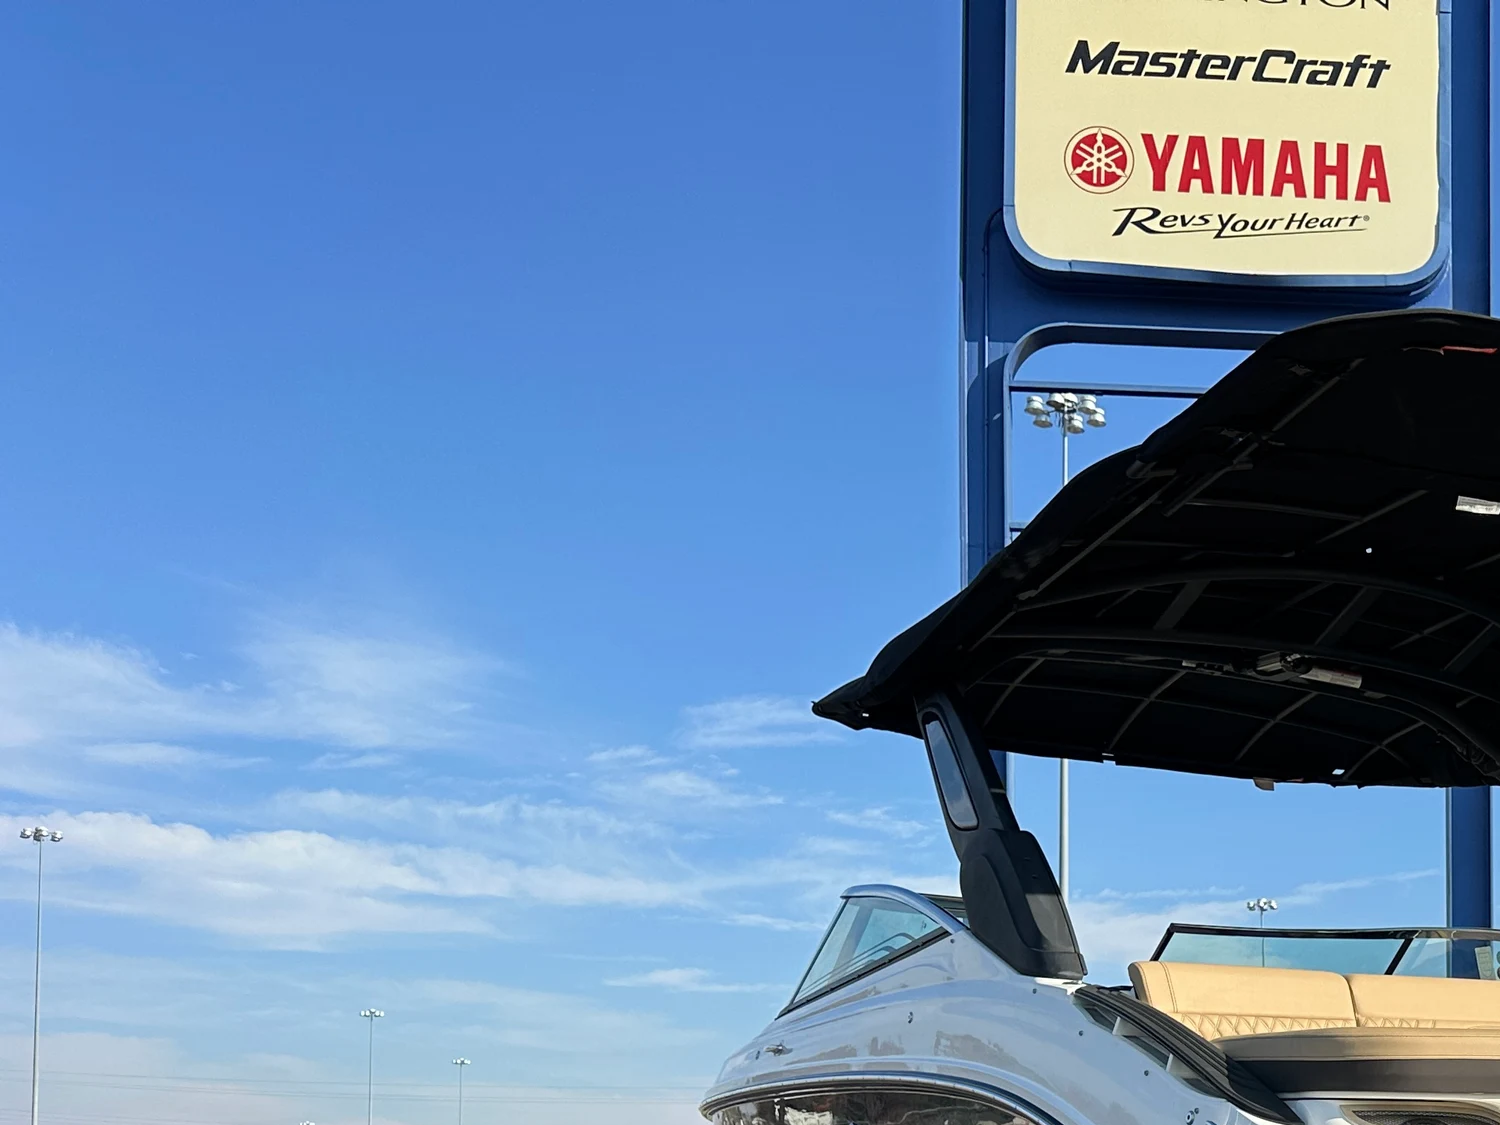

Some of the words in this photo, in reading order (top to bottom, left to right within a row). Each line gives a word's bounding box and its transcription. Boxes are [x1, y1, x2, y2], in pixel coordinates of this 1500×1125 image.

[1065, 39, 1391, 88] MasterCraft
[1141, 133, 1391, 203] YAMAHA
[1112, 207, 1213, 237] Revs
[1213, 212, 1285, 239] Your
